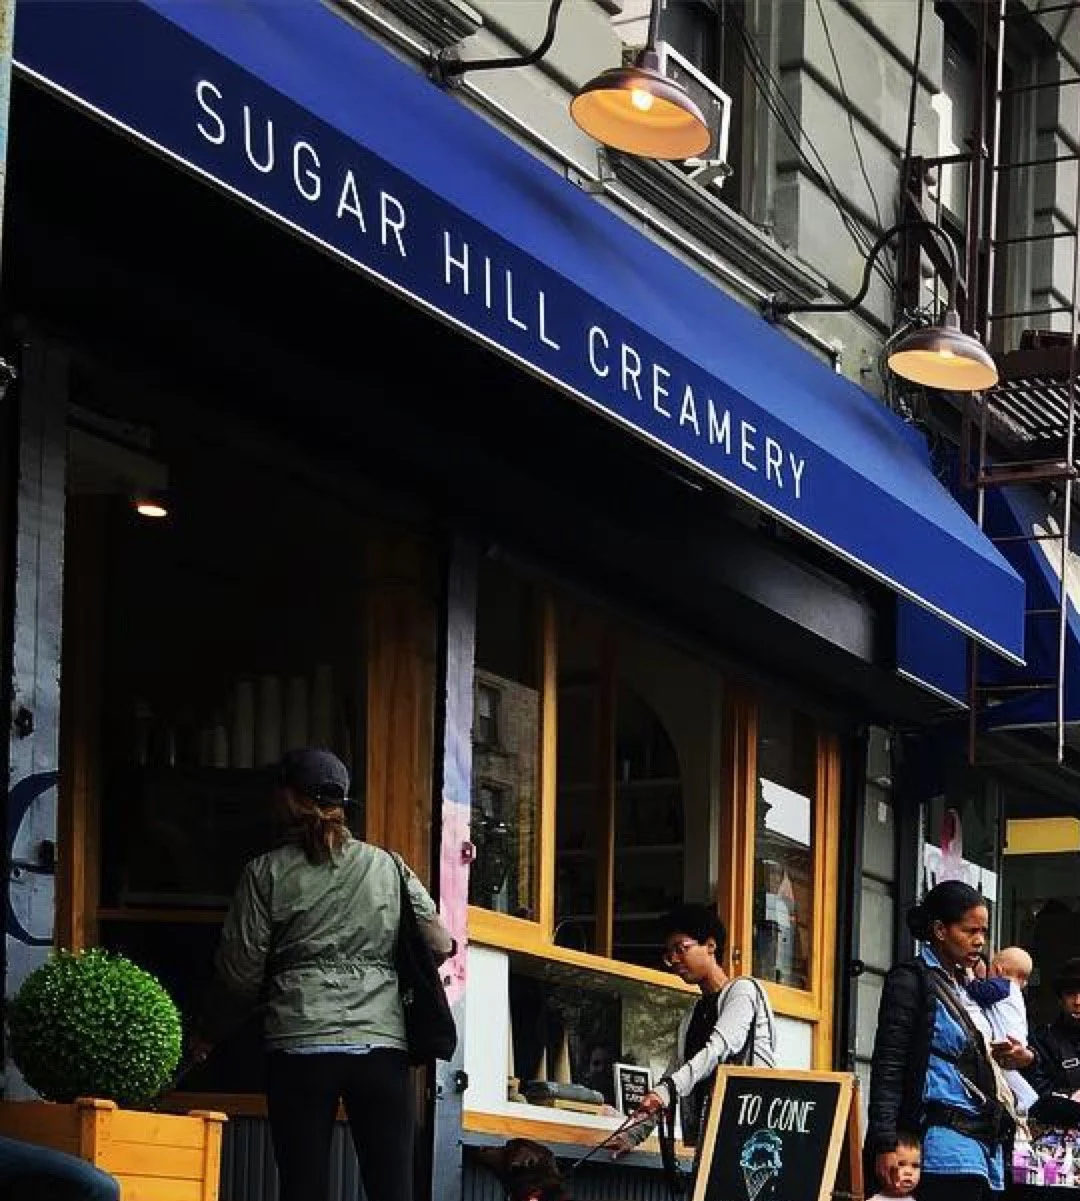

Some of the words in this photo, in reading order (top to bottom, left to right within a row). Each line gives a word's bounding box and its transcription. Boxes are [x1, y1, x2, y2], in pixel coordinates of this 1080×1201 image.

[195, 79, 408, 257] SUGAR
[443, 231, 561, 351] HILL
[587, 325, 806, 500] CREAMERY
[737, 1093, 762, 1125] TO
[767, 1097, 817, 1134] CONE
